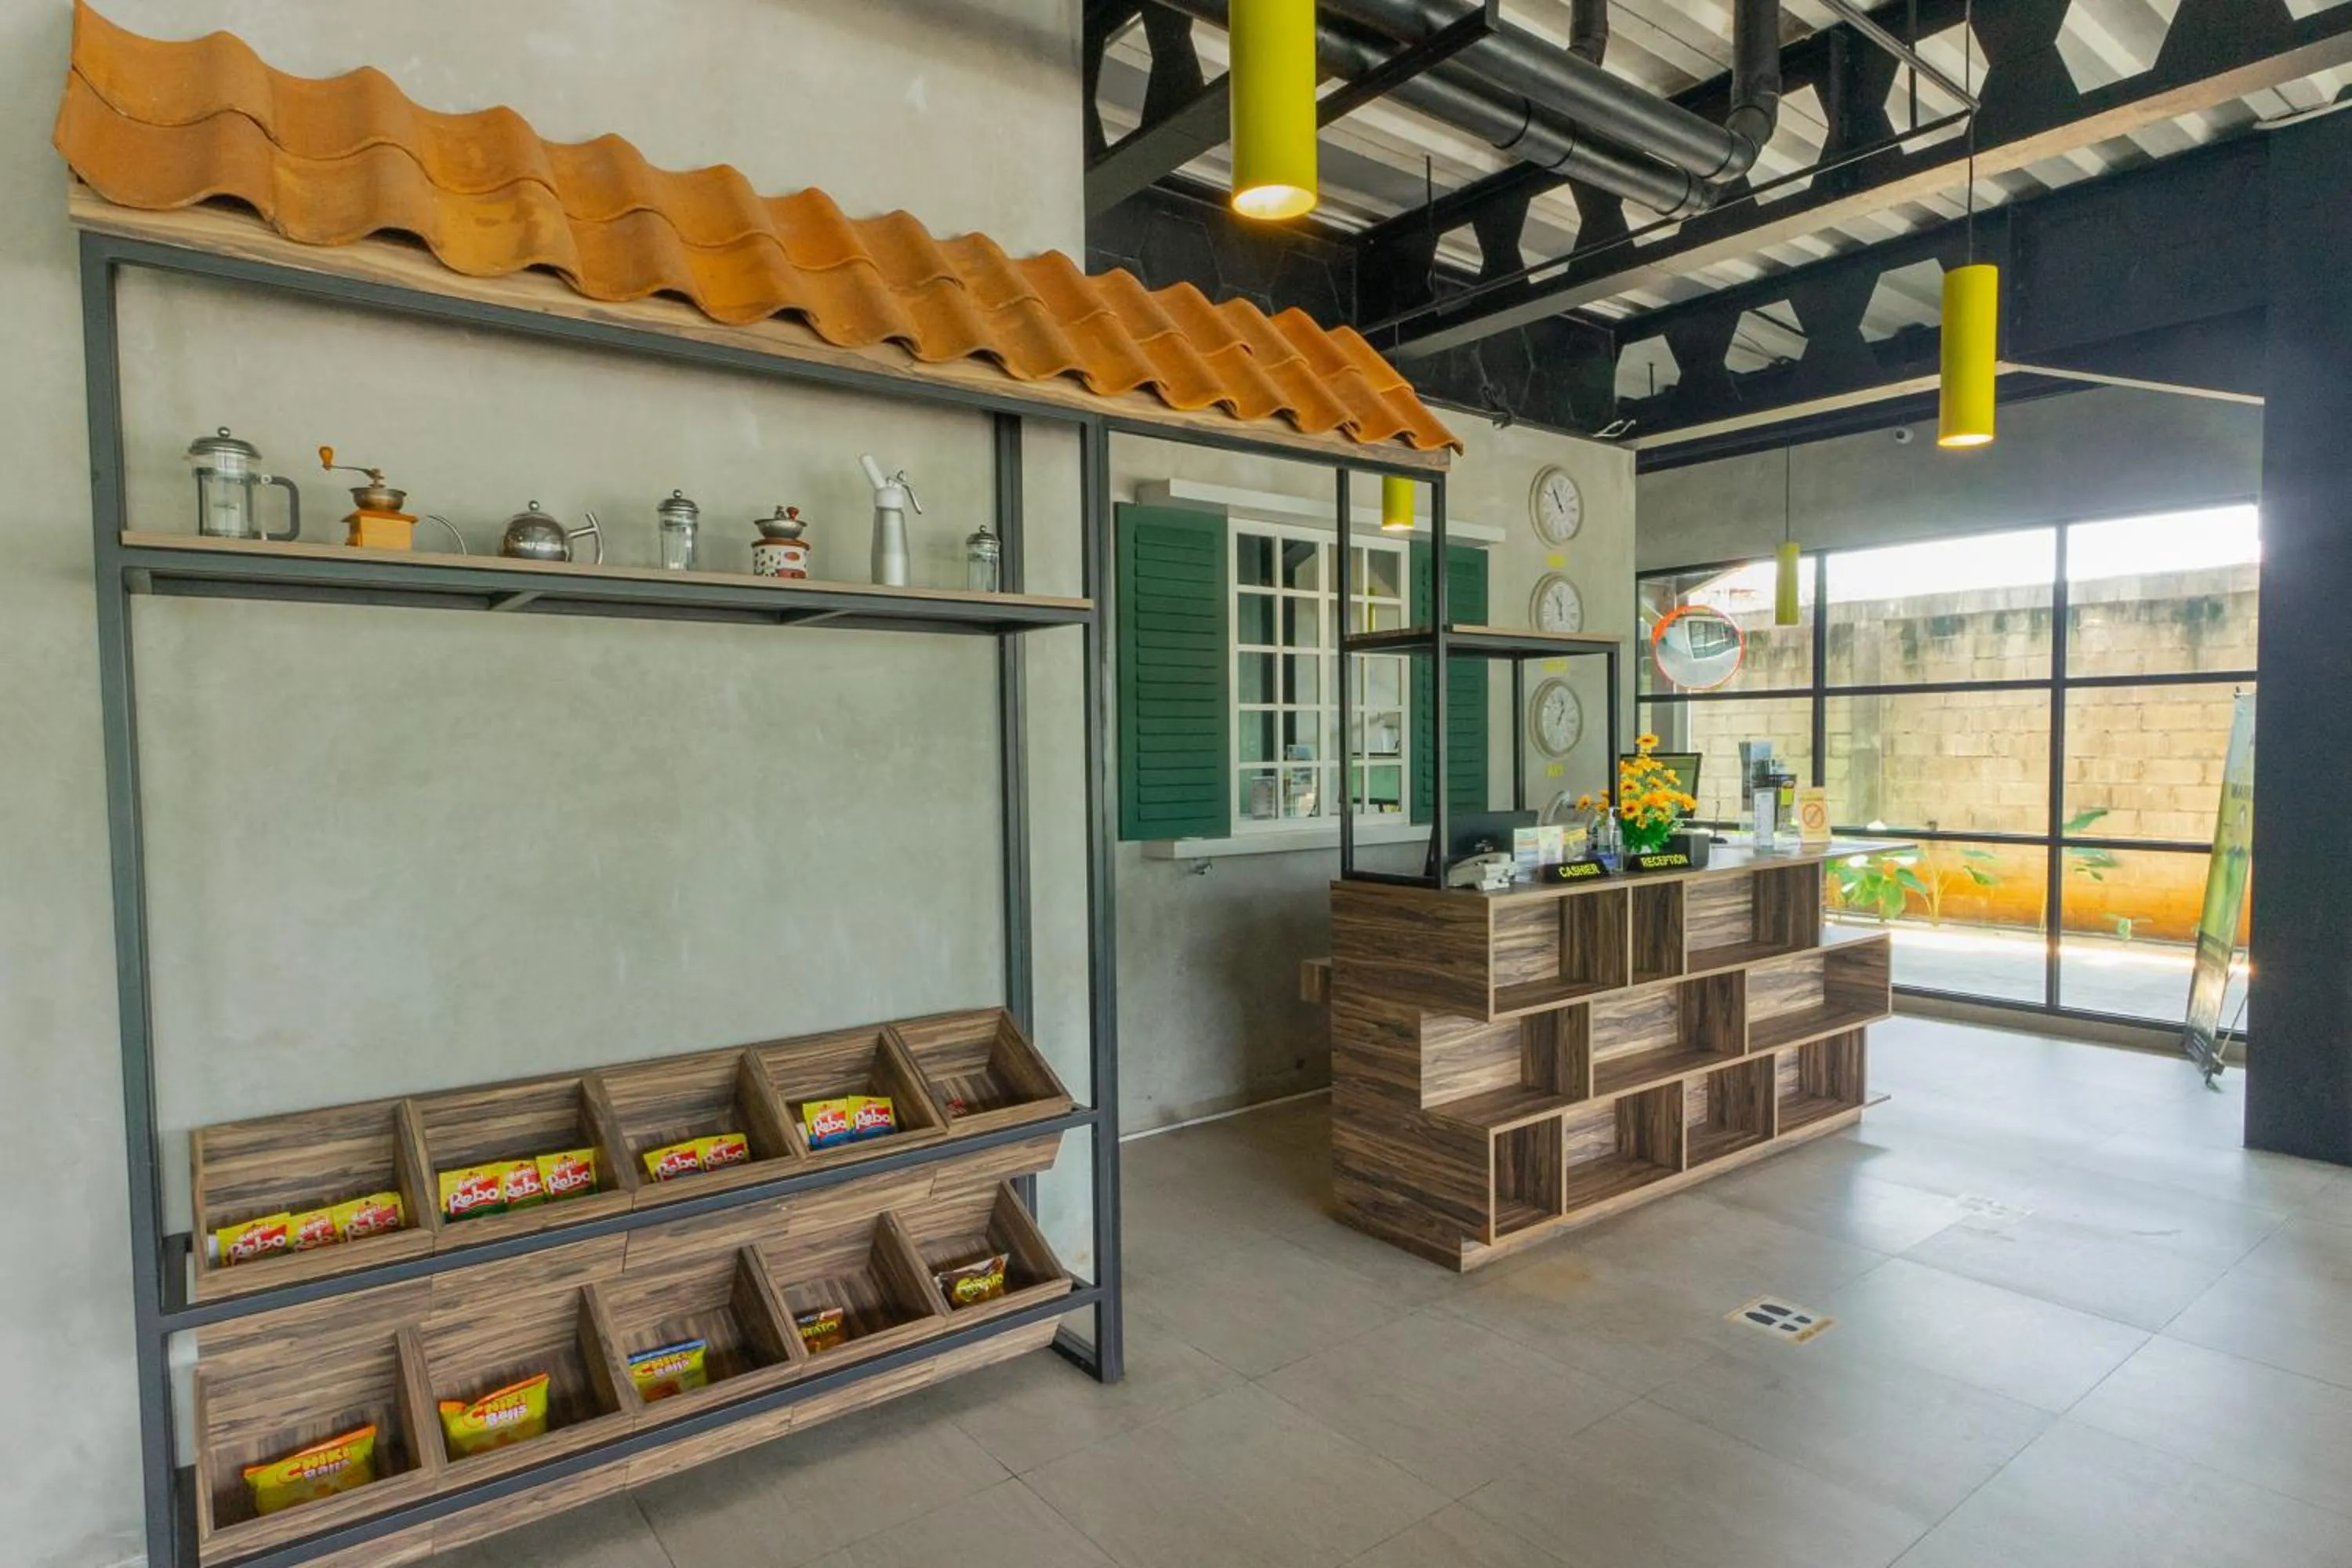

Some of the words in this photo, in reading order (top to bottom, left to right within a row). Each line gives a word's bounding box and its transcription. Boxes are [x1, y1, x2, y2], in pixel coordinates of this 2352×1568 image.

[1558, 863, 1599, 878] CASHIER
[1640, 854, 1688, 867] RECEPTION
[812, 1113, 848, 1137] Rebo
[852, 1106, 891, 1131] Rebo
[546, 1168, 592, 1195] Rebo
[655, 1156, 698, 1182] Rebo
[448, 1184, 499, 1214] Rebo
[343, 1214, 397, 1243] Rebo
[226, 1234, 286, 1265] Rebo
